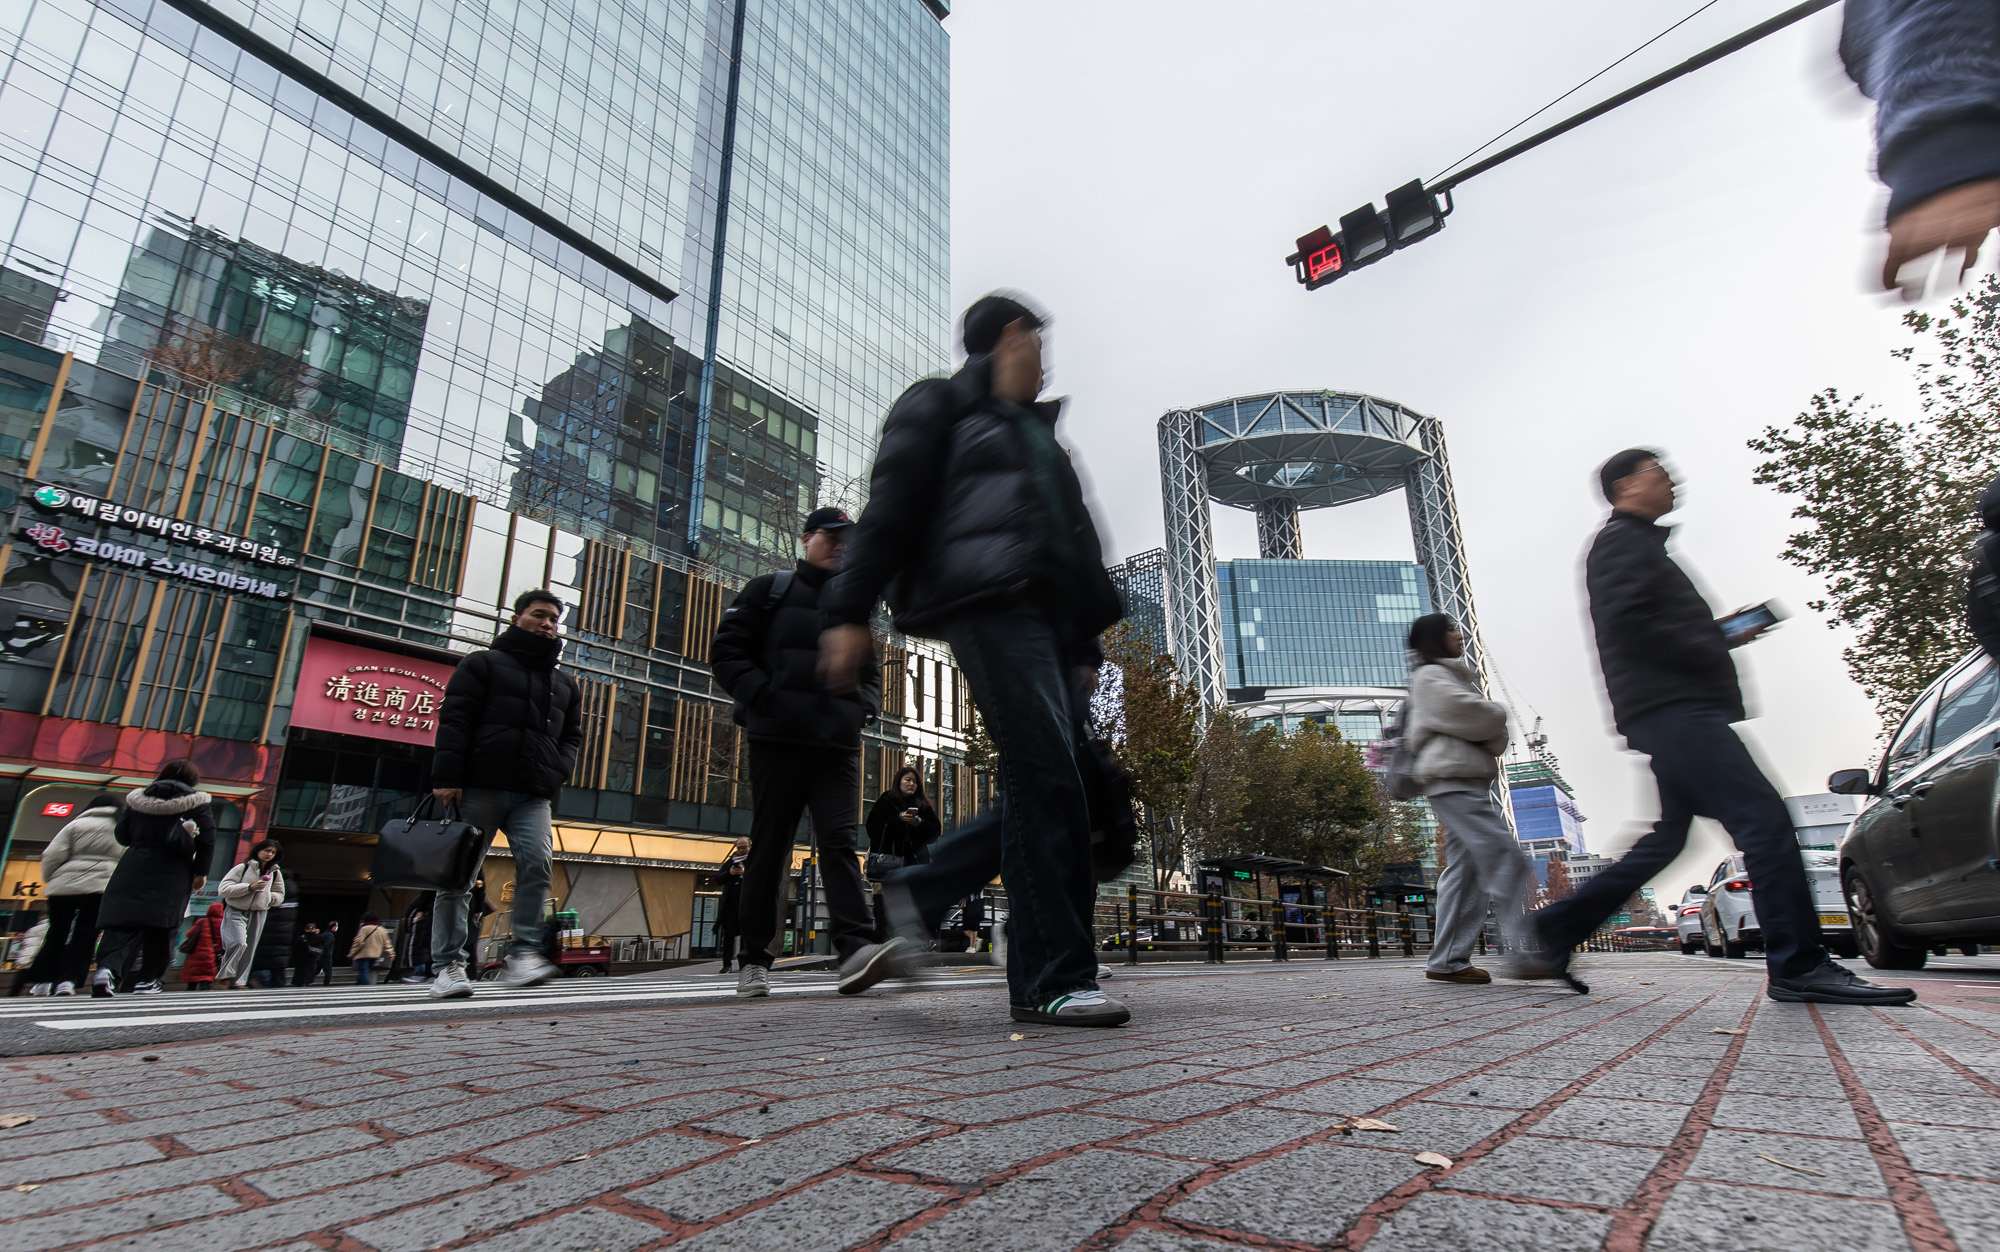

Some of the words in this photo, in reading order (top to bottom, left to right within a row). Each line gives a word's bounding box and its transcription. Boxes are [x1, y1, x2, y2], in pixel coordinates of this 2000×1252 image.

[71, 496, 278, 563] 예림이비인후과의원
[277, 555, 297, 566] 3F
[72, 536, 147, 567] 코야마
[150, 556, 278, 598] 스시오마카세
[348, 665, 379, 673] GRAN
[382, 666, 418, 677] SEOUL
[420, 674, 446, 691] MALL
[47, 804, 69, 815] 5G
[12, 881, 42, 896] kt
